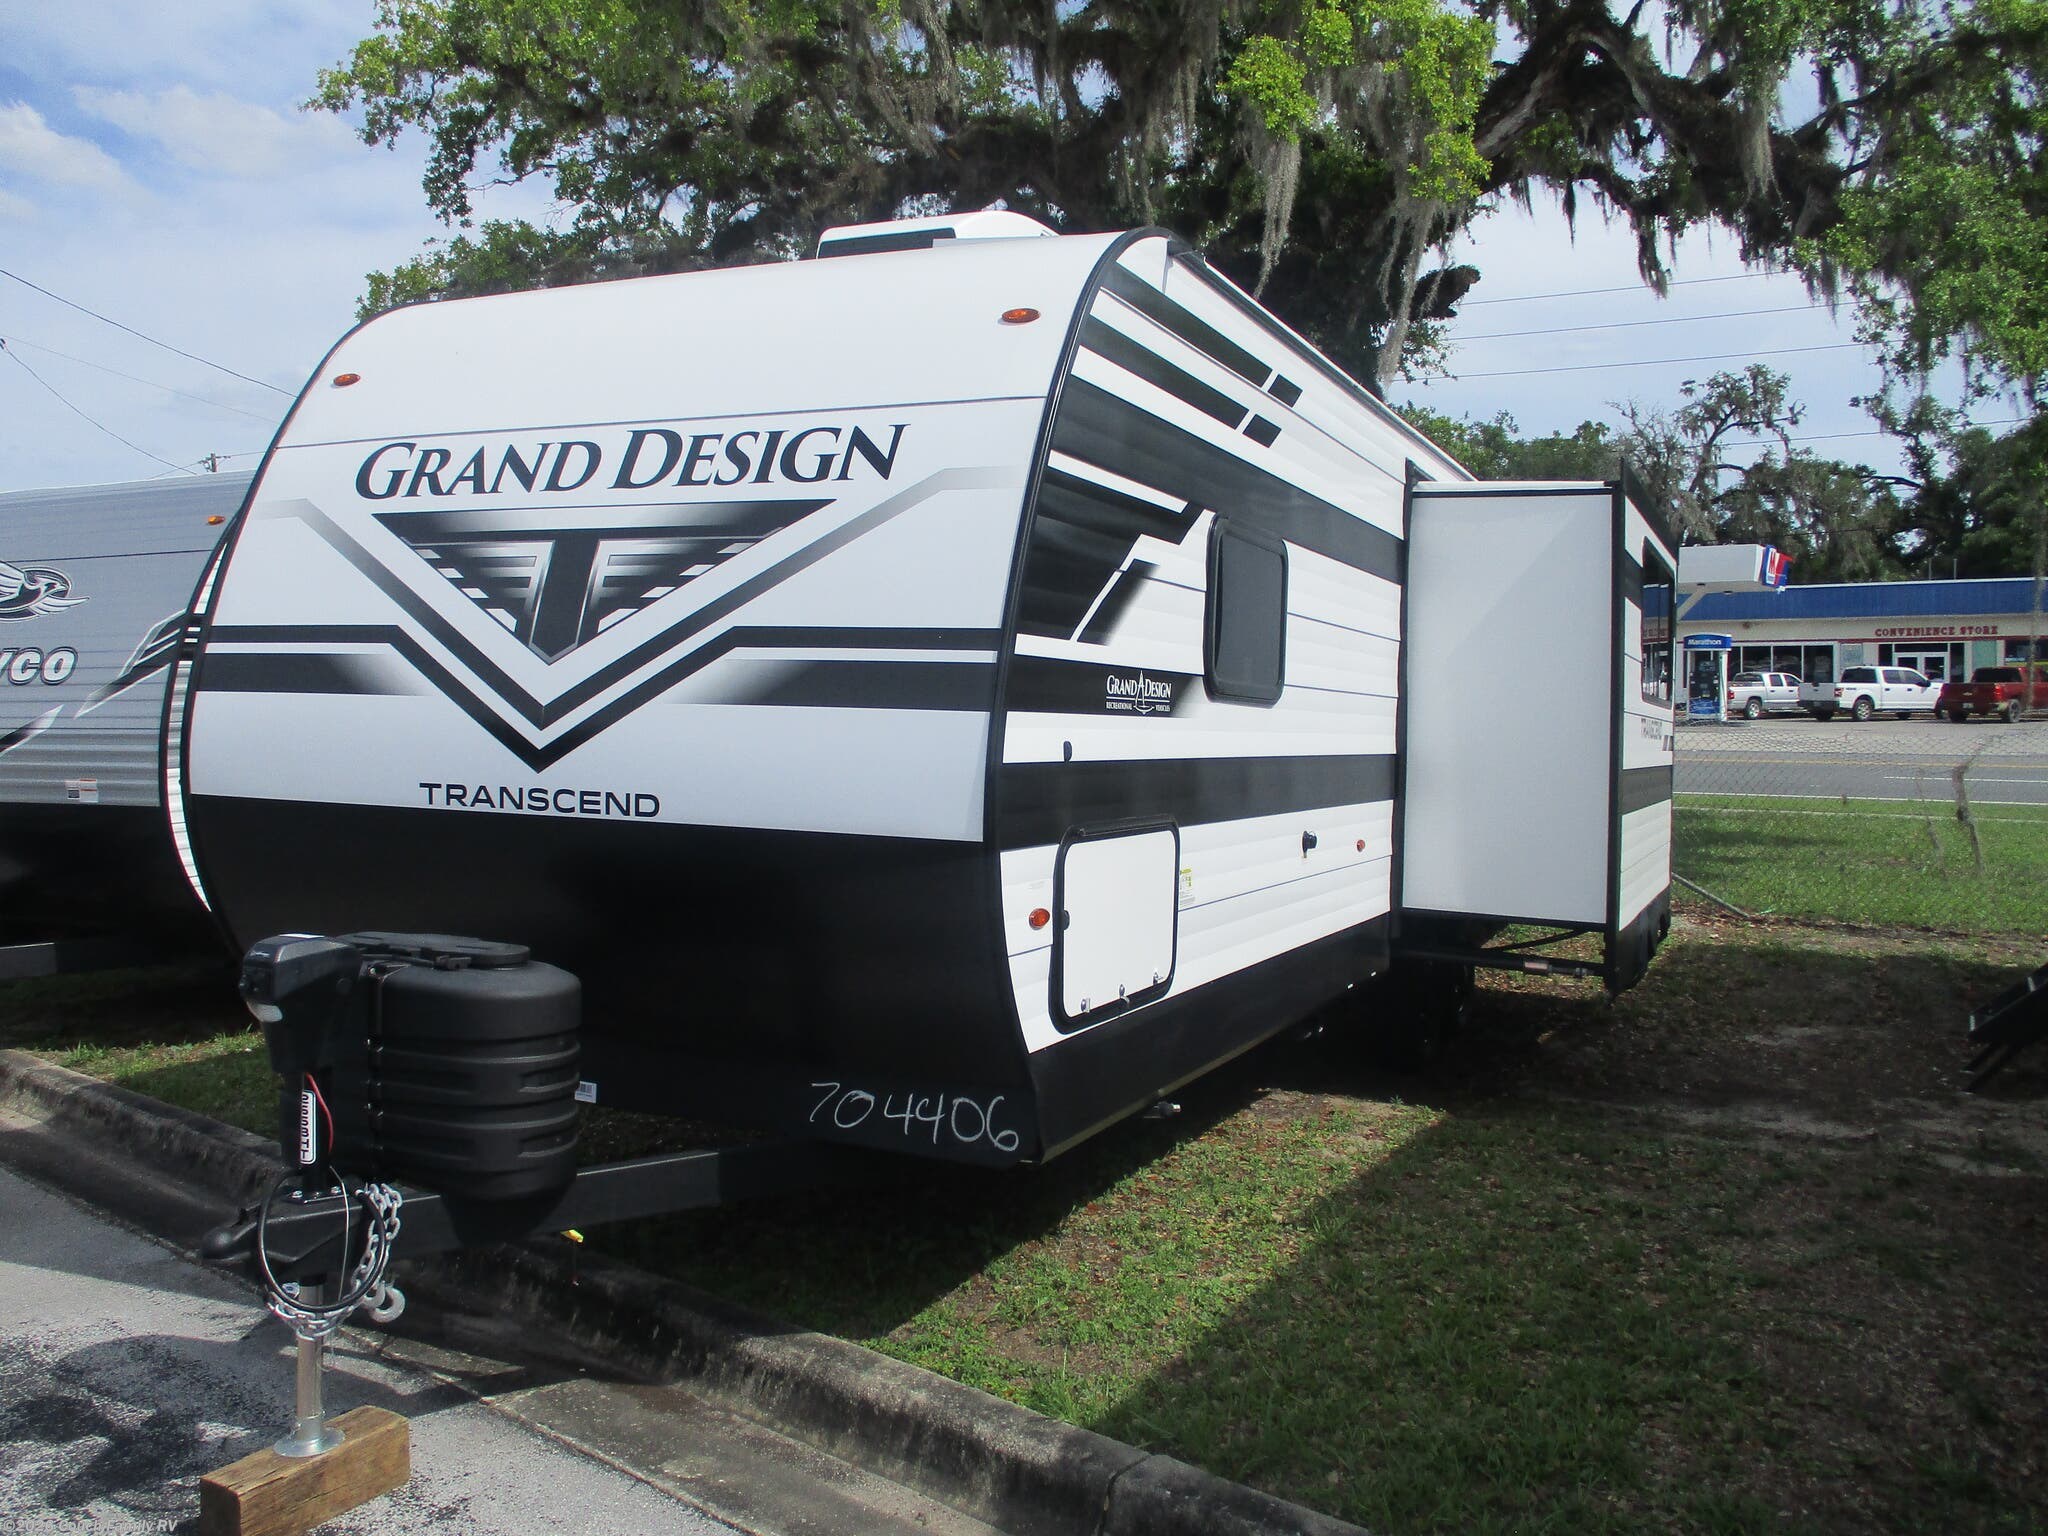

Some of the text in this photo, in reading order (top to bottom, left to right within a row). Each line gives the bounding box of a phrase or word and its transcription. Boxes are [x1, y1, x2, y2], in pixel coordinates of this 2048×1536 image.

[355, 422, 911, 500] GRAND DESIGN
[1875, 625, 1998, 637] CONVENIENCE STORE
[1106, 674, 1172, 698] GRAND DESIGN
[419, 782, 660, 818] TRANSCEND
[810, 1082, 1019, 1152] 704406
